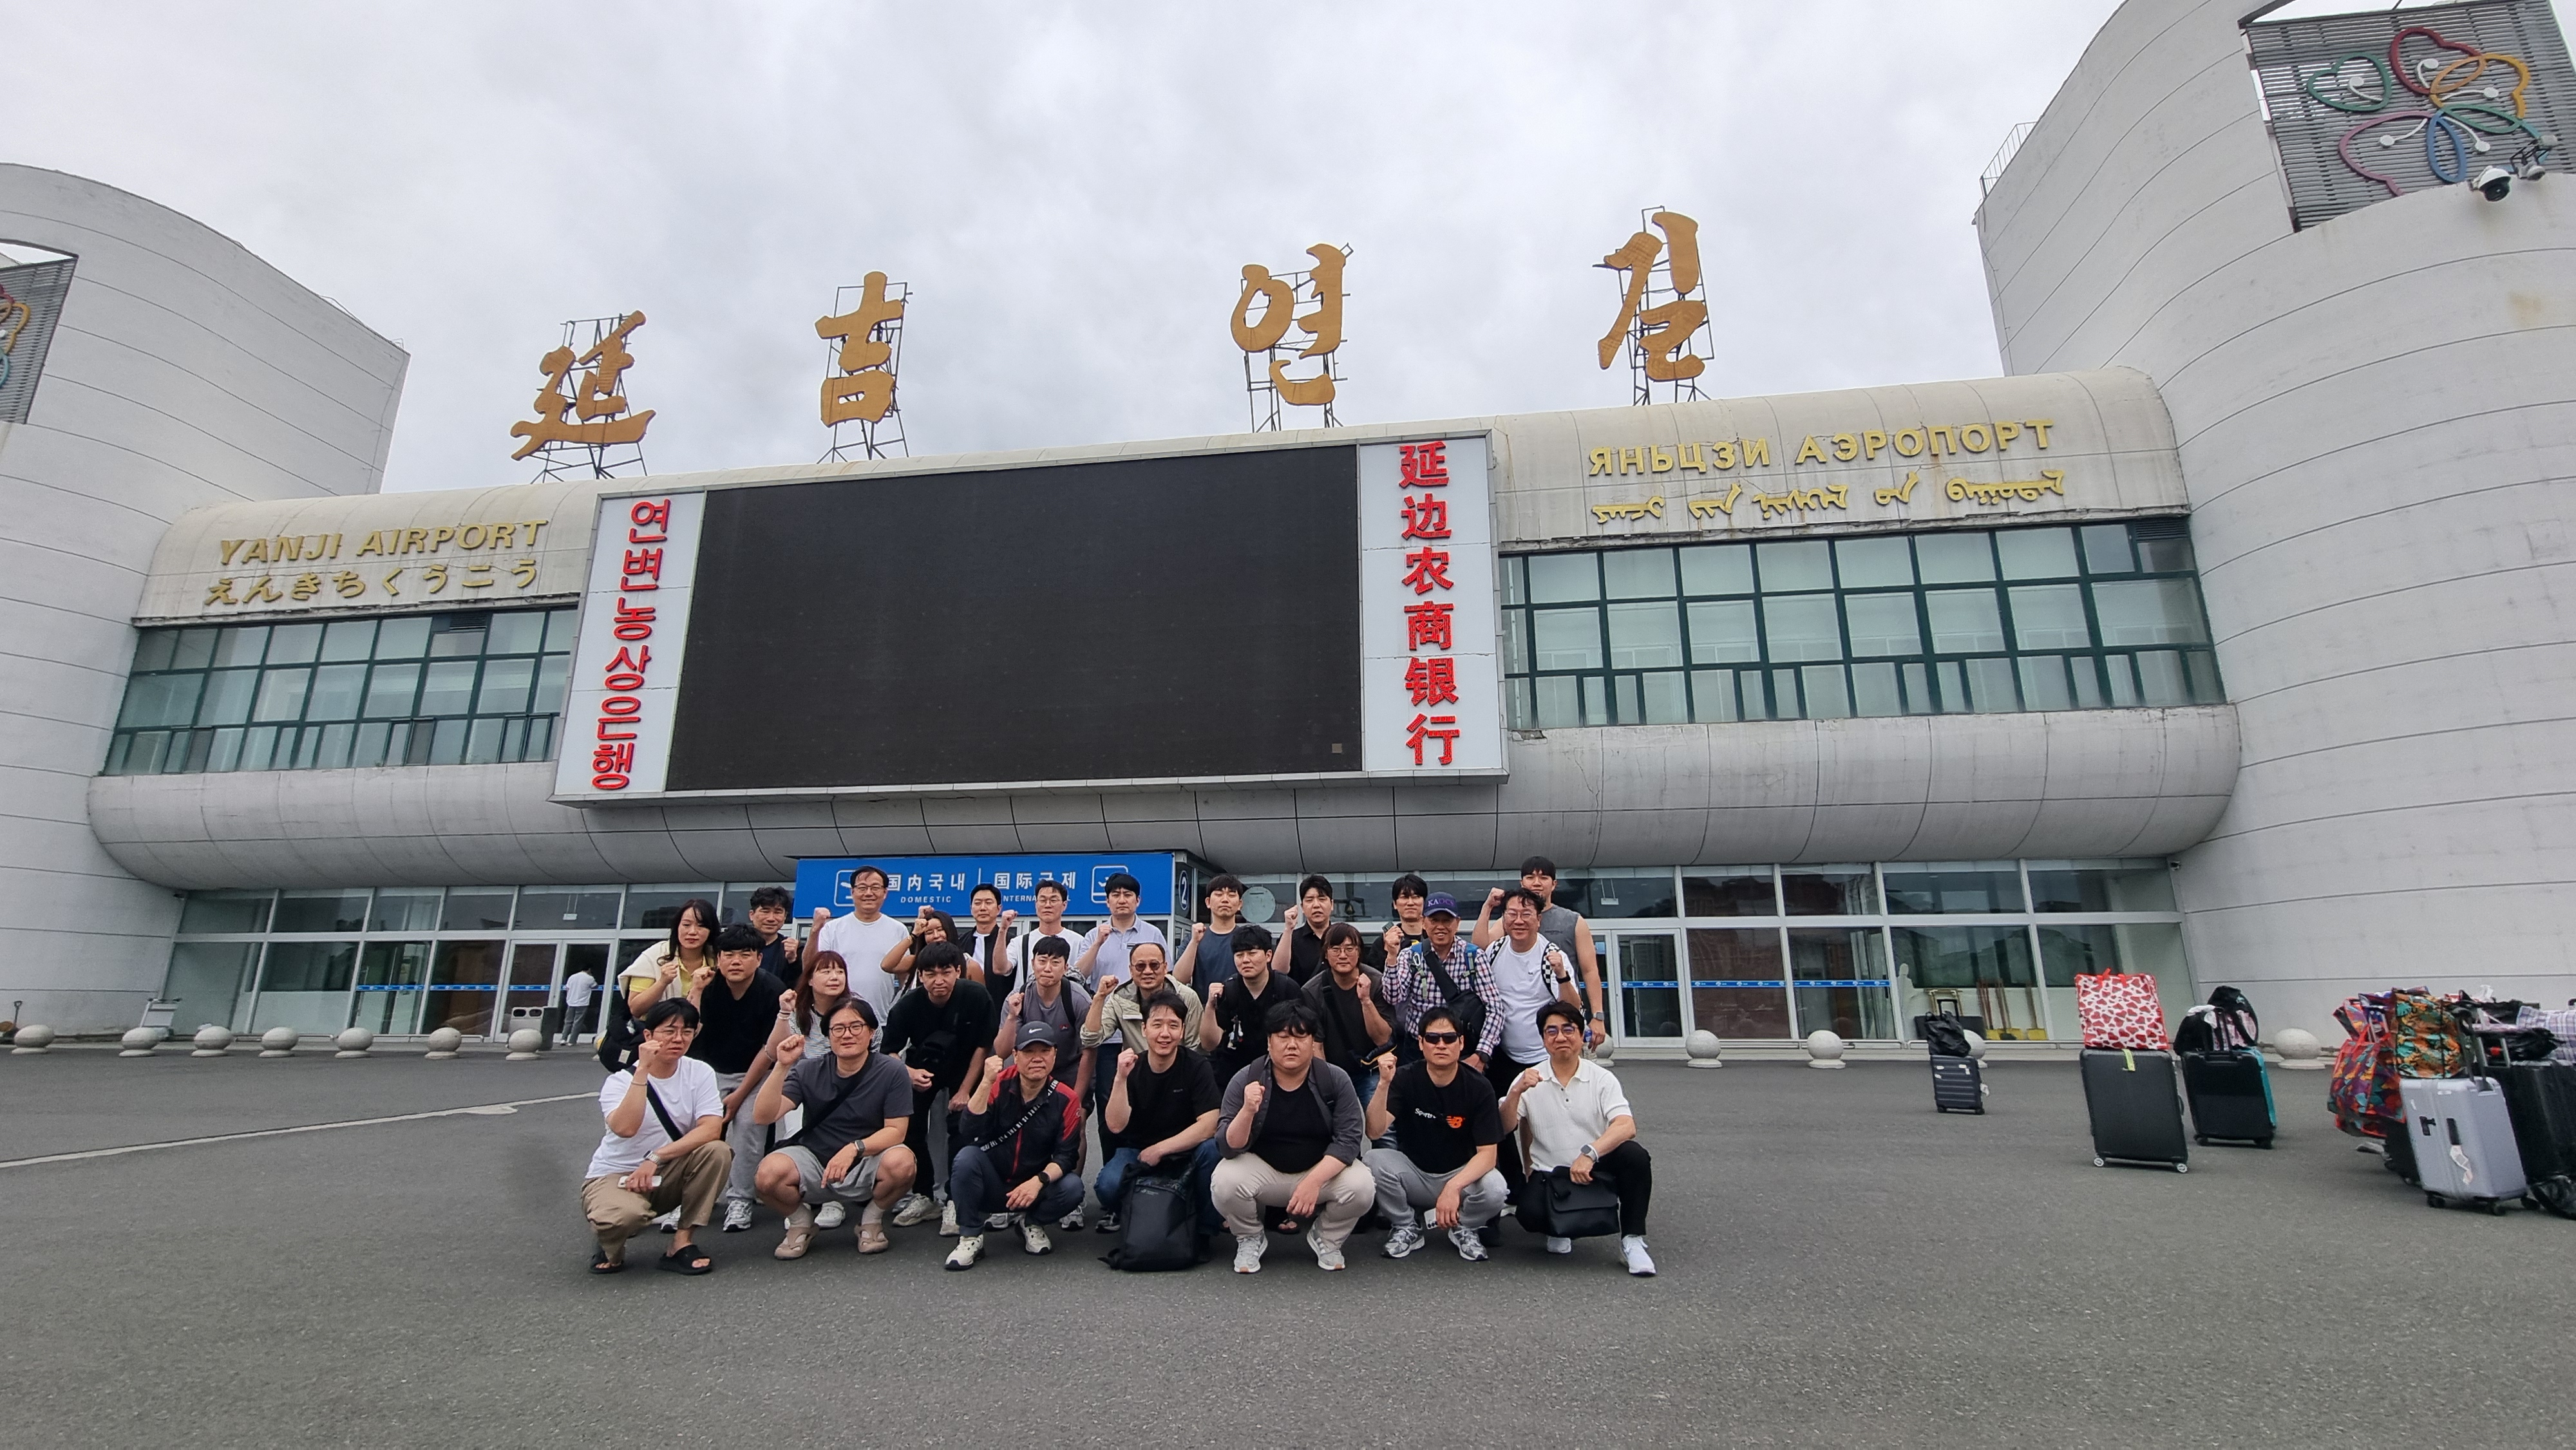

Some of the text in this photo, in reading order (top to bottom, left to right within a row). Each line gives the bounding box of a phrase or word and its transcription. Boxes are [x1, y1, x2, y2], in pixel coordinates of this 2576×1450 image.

[1589, 419, 2054, 476] ЯНЬЦЗИ АЭРОПОРТ
[220, 519, 548, 565] YANJI AIRPORT
[204, 558, 537, 606] えんきちくうこう
[1399, 440, 1460, 765] 延边农商银行
[591, 498, 671, 791] 연변농상은행
[1181, 876, 1187, 905] 2
